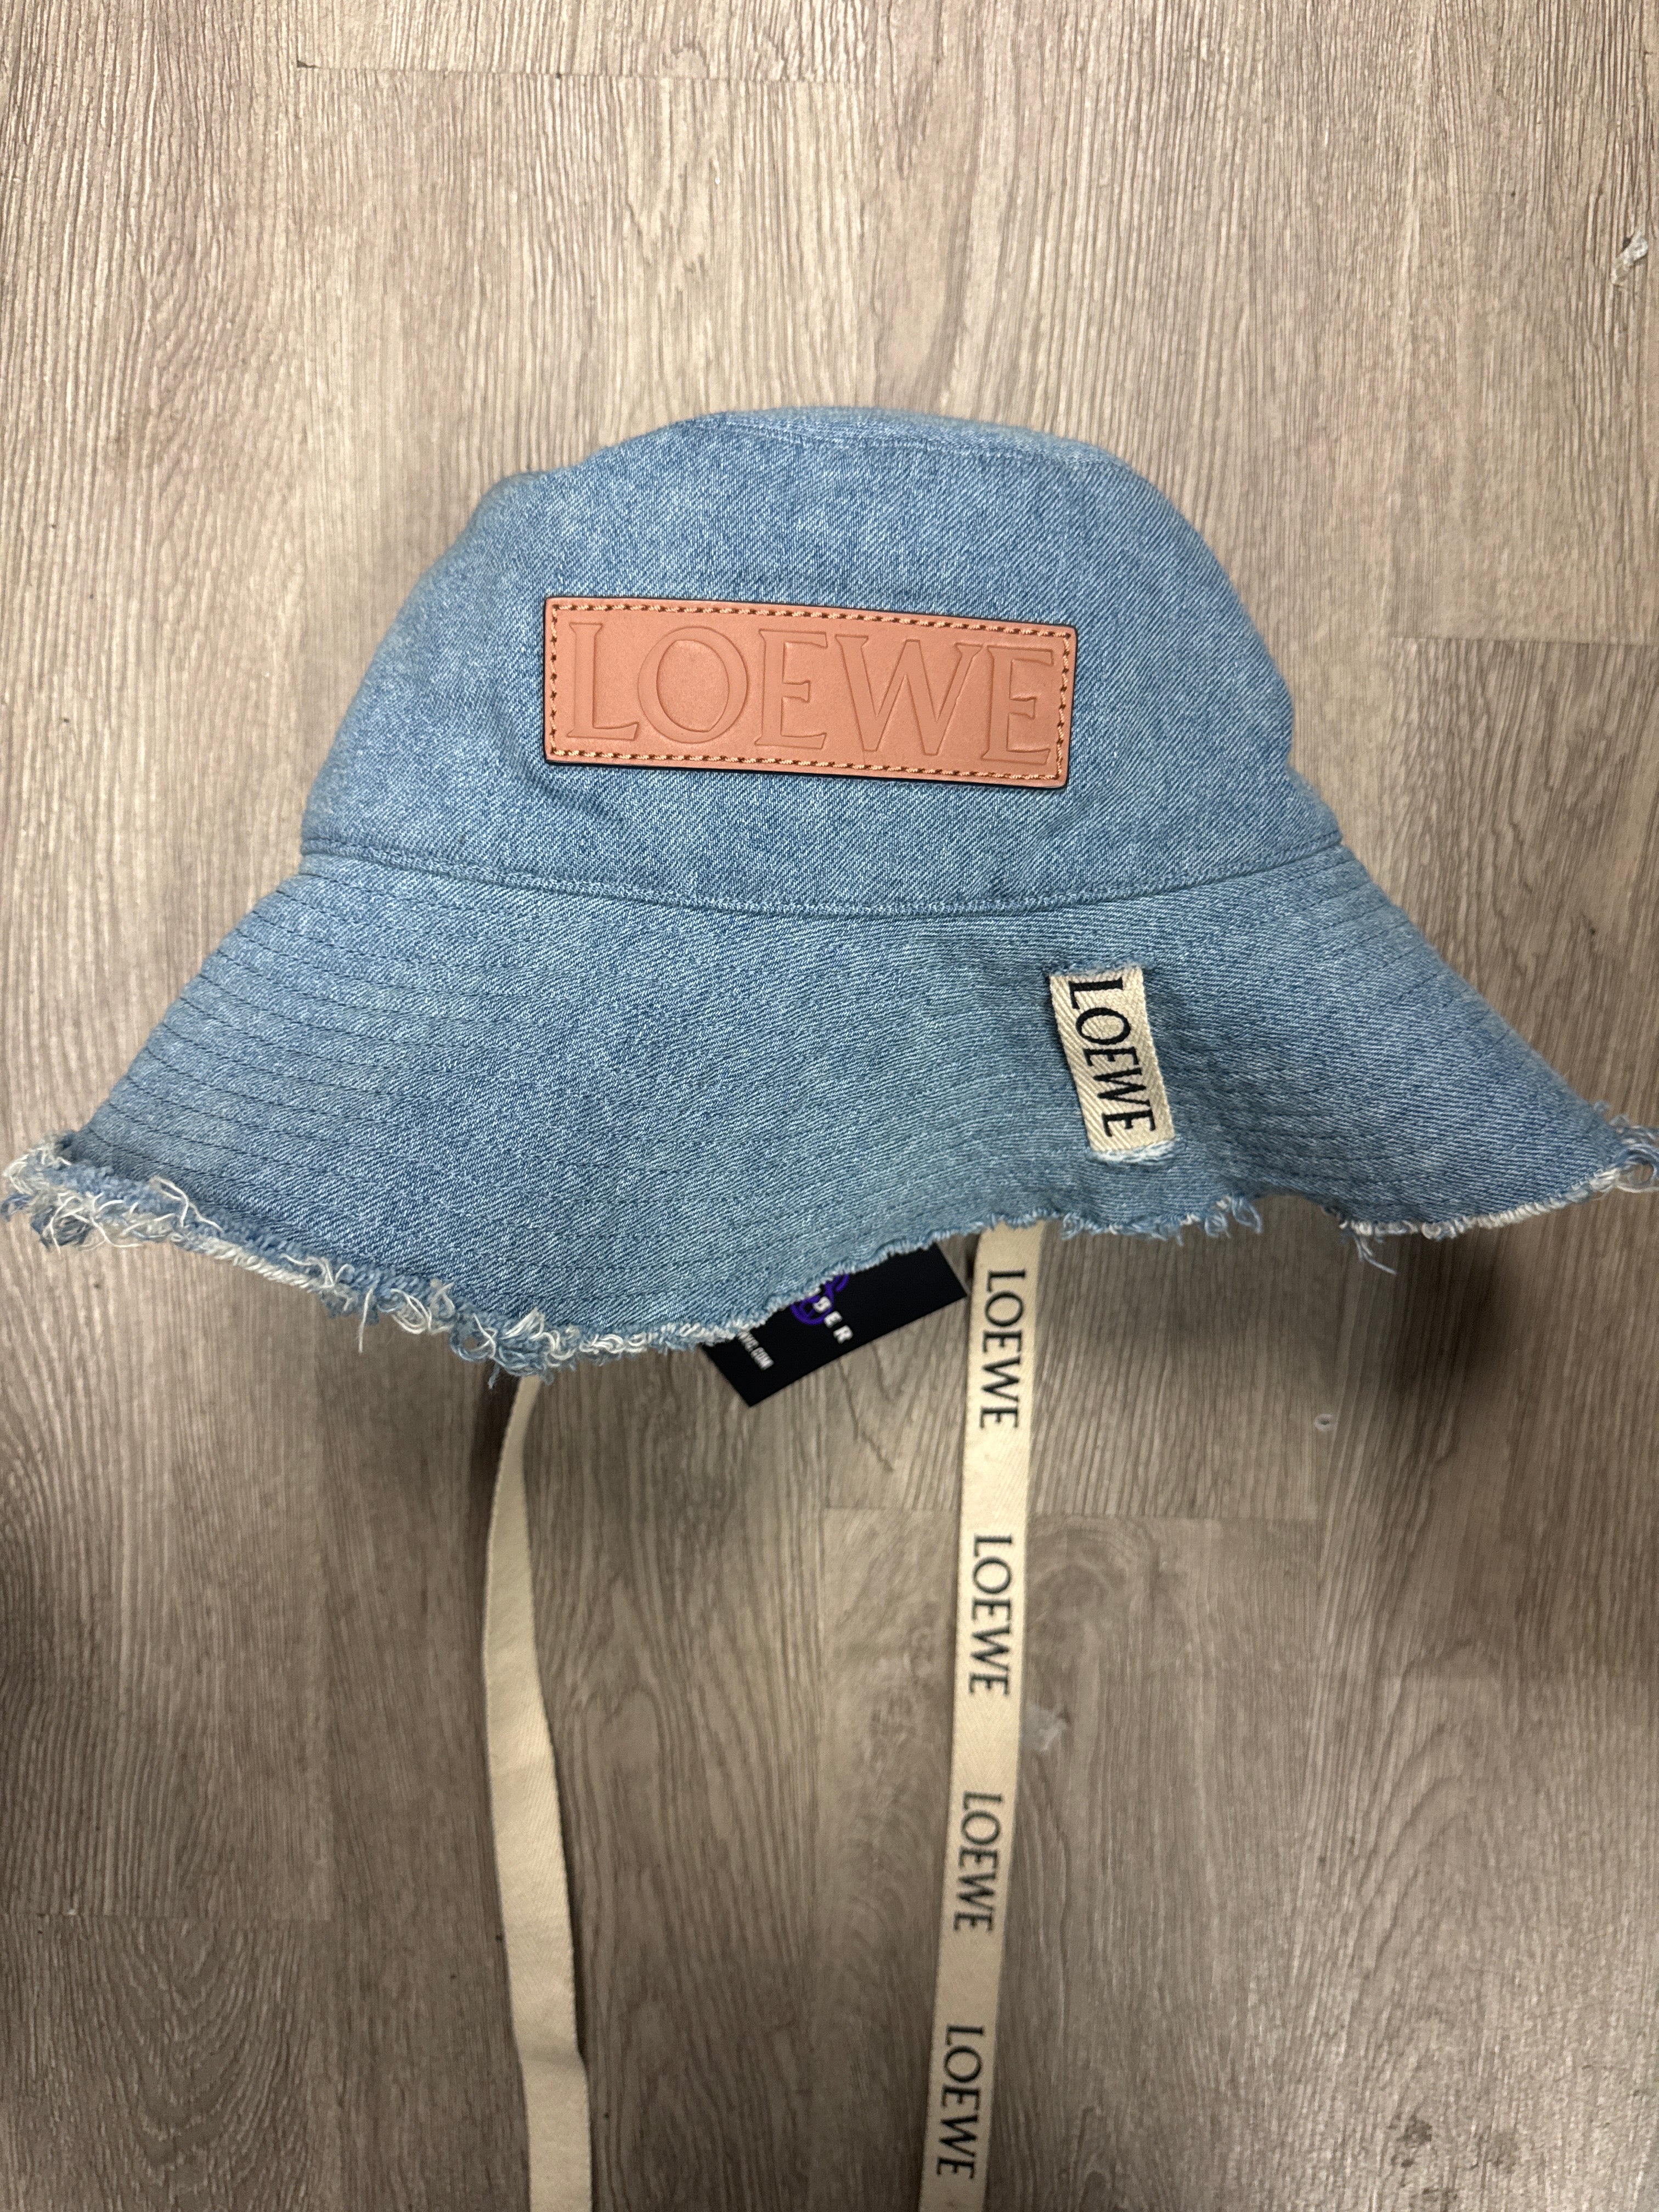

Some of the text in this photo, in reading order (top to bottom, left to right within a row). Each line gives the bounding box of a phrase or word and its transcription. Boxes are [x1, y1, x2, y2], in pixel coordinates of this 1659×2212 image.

[567, 622, 1054, 764] LOEWE
[1068, 977, 1156, 1137] LOEWE
[809, 1286, 854, 1344] SER
[979, 1269, 1026, 1429] LOEWE
[968, 1533, 1012, 1697] LOEWE
[953, 1791, 1003, 1932] LOEWE
[936, 2024, 985, 2180] LOEWE
